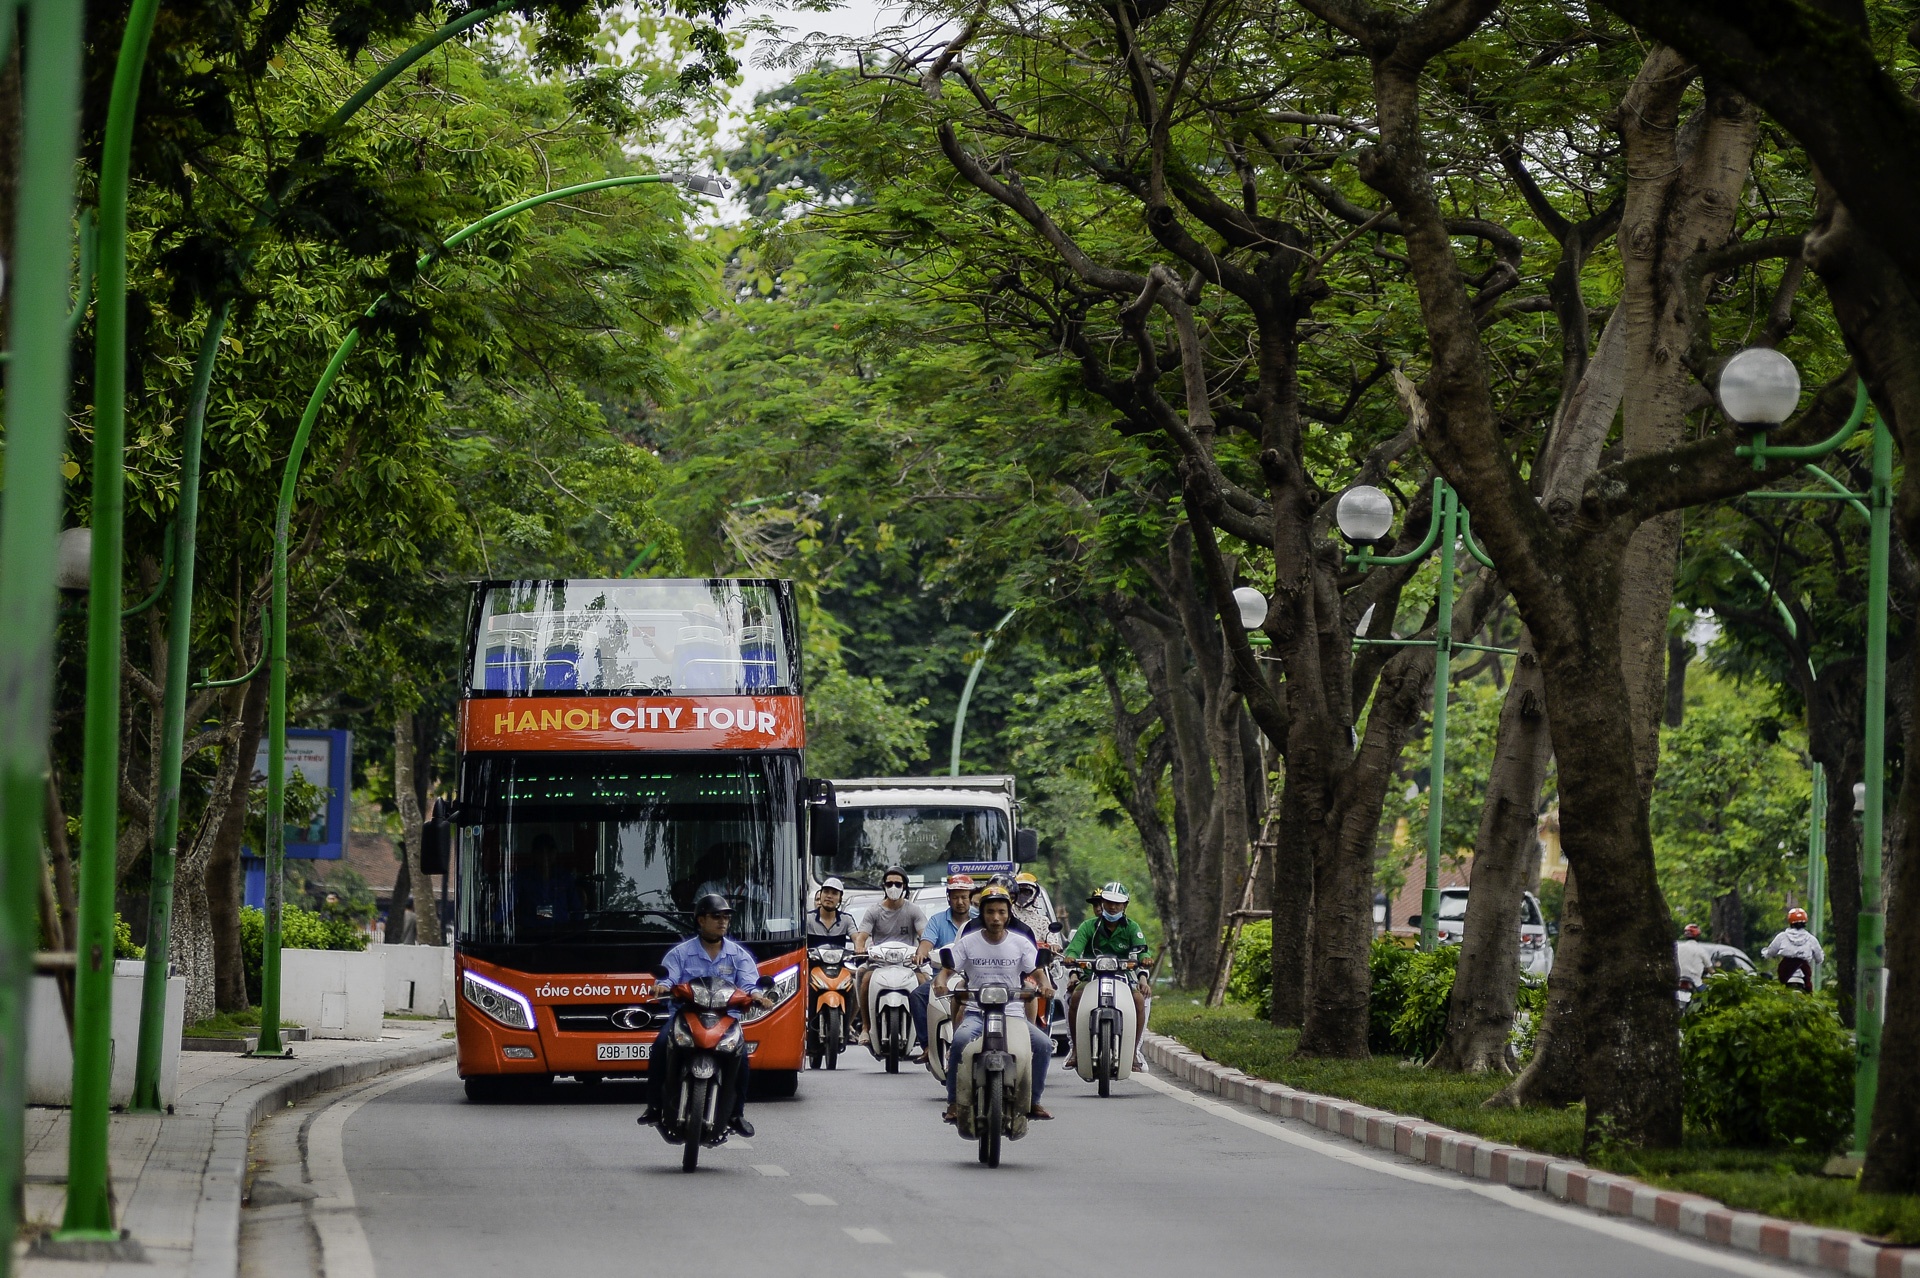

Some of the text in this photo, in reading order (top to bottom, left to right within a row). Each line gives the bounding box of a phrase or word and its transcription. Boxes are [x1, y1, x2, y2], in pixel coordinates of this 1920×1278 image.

[494, 707, 776, 736] HANOI CITY TOUR
[535, 982, 570, 997] TỔNG
[573, 983, 611, 996] CÔNG
[613, 985, 627, 996] TY
